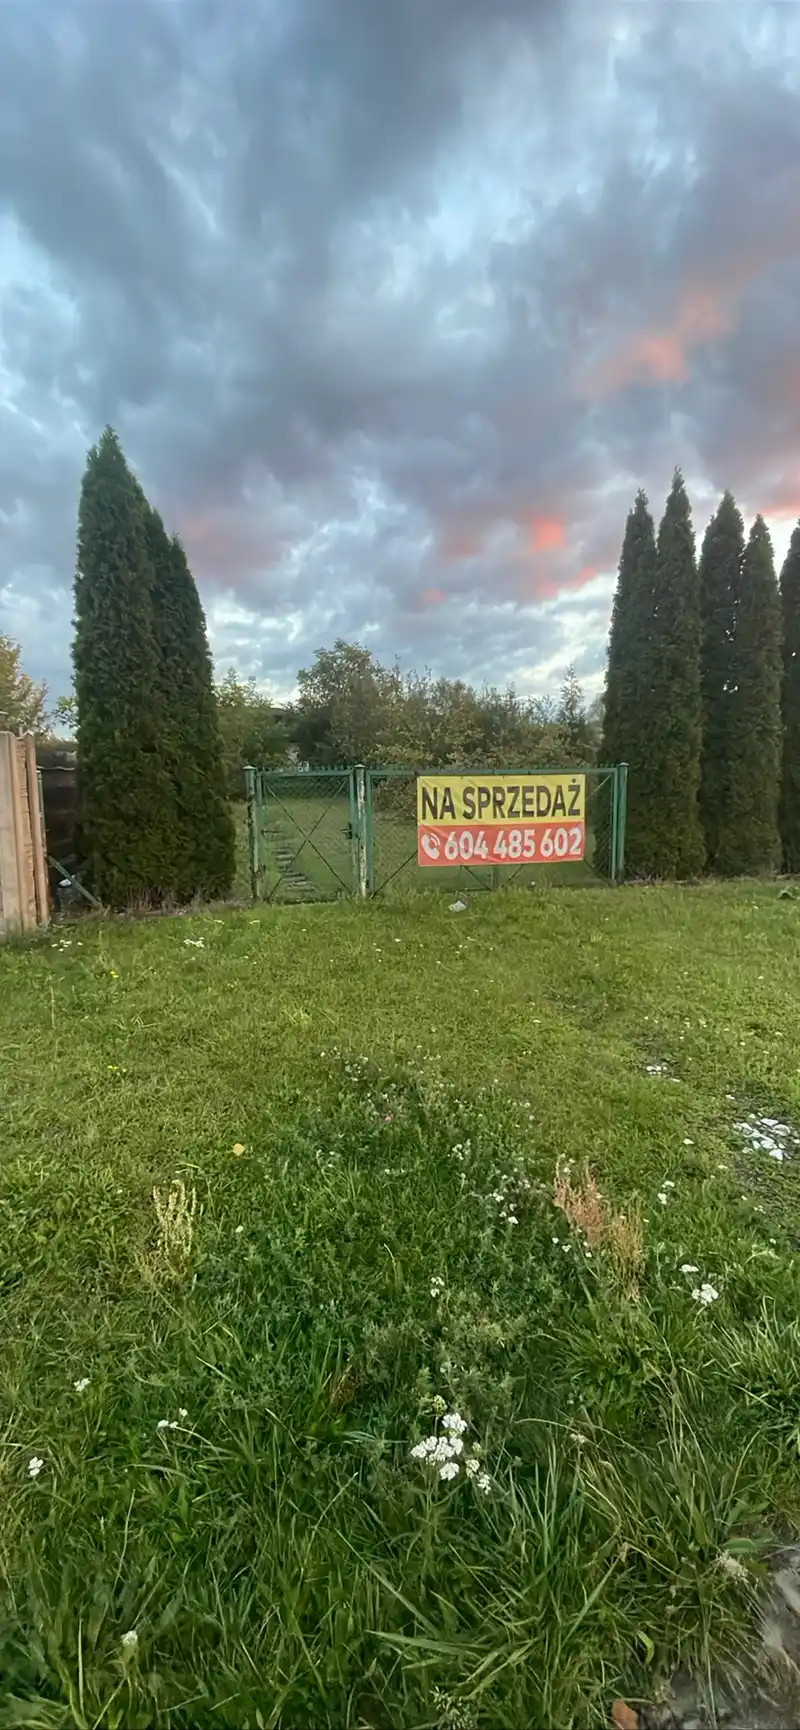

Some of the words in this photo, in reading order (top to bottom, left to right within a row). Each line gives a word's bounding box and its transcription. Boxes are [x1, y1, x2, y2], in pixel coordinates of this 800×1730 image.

[421, 786, 456, 820] NA
[462, 778, 581, 820] SPRZEDAŻ
[444, 831, 488, 860] 604
[493, 829, 536, 859] 485
[540, 827, 582, 857] 602
